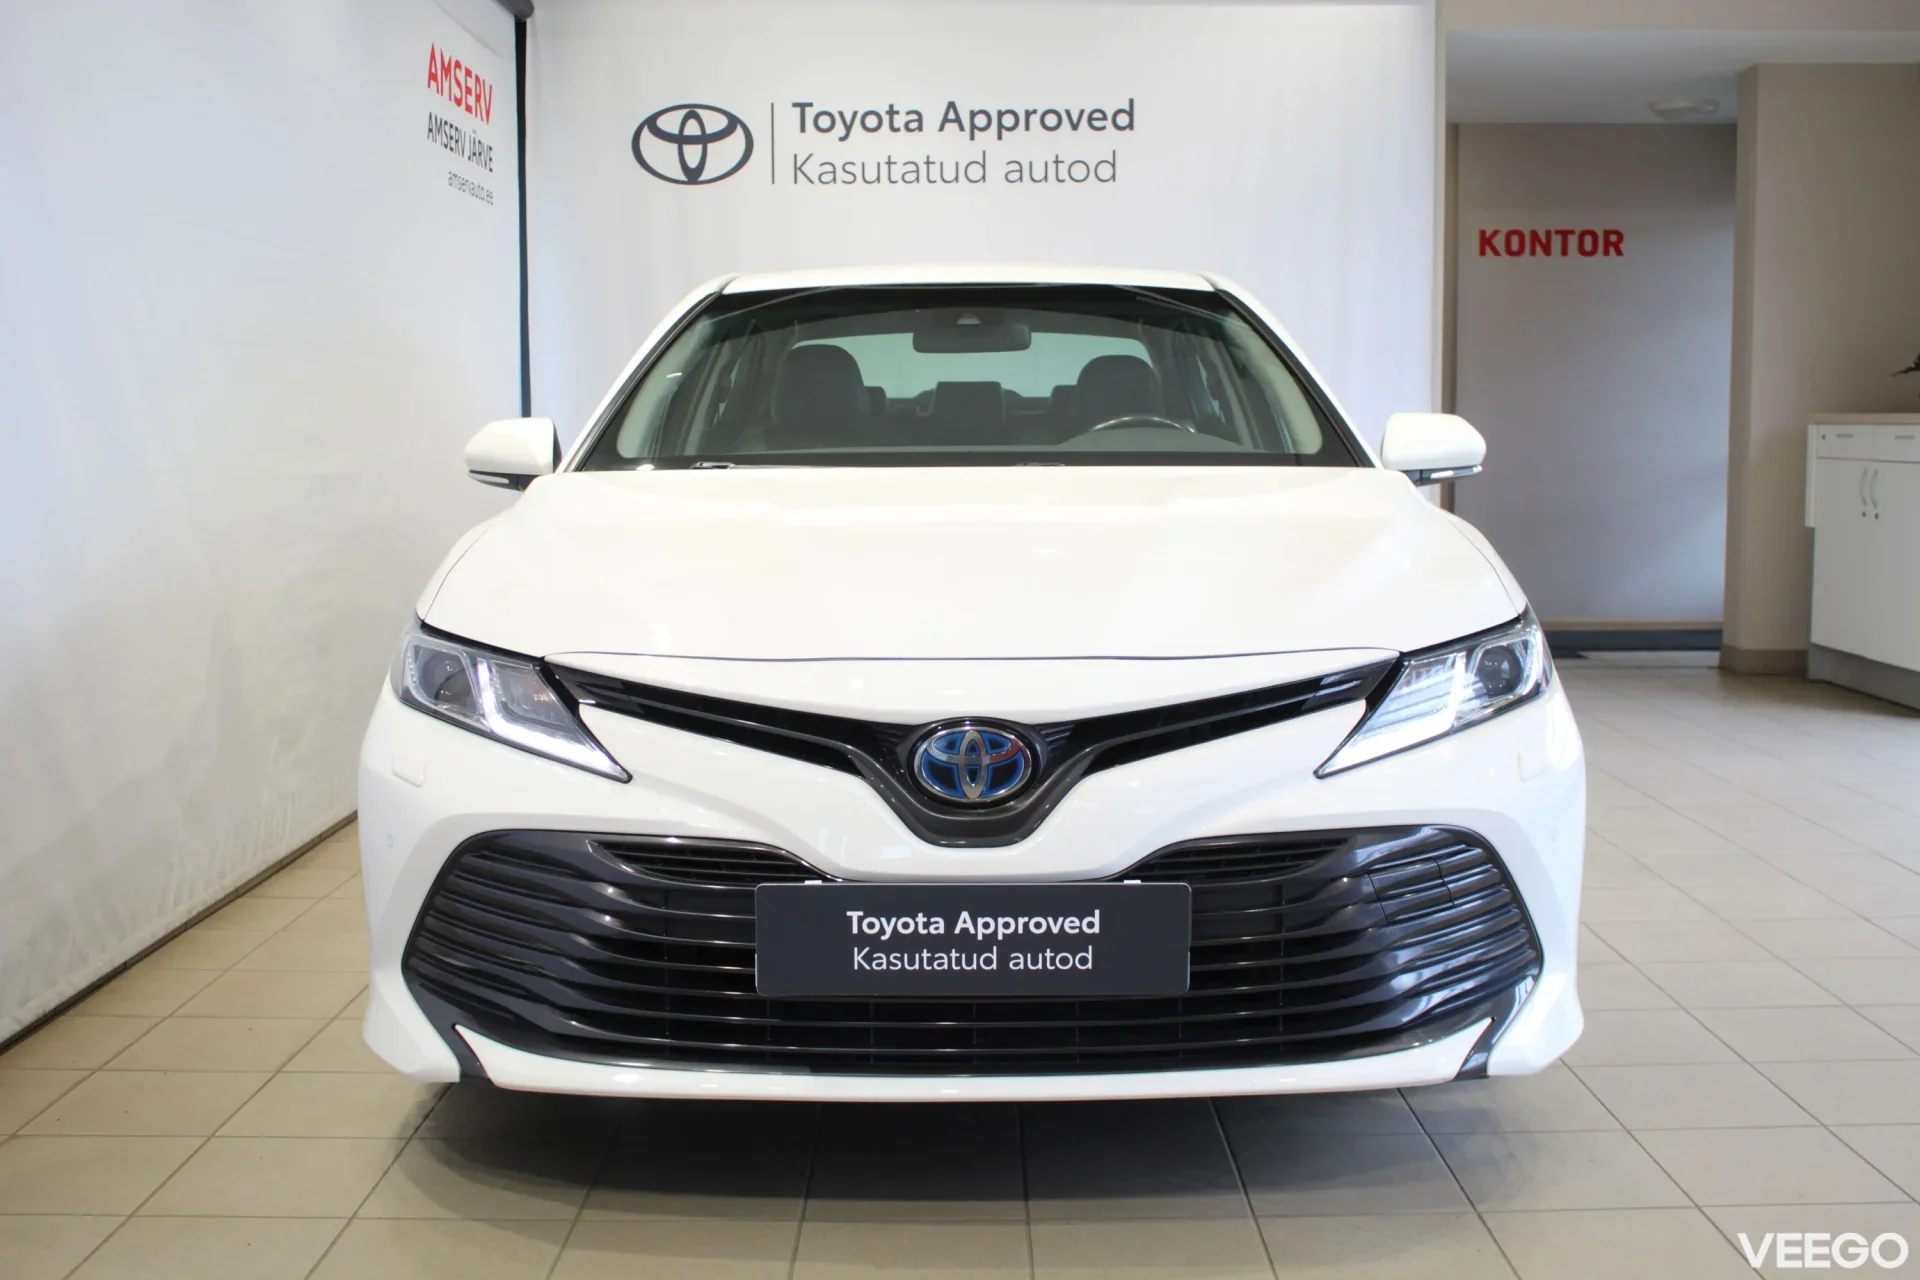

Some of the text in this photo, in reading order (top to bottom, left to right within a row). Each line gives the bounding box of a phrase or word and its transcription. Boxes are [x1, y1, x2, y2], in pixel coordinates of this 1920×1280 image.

[427, 42, 493, 125] AMSERV
[792, 98, 1136, 142] Toyota Approved
[427, 111, 493, 173] AMSERV JÄRVE
[793, 150, 1118, 185] Kasutatud autod
[448, 170, 494, 206] amservauto.ee
[1478, 228, 1625, 258] KONTOR
[846, 908, 1101, 941] Toyota Approved
[853, 945, 1093, 970] Kasutatud autod
